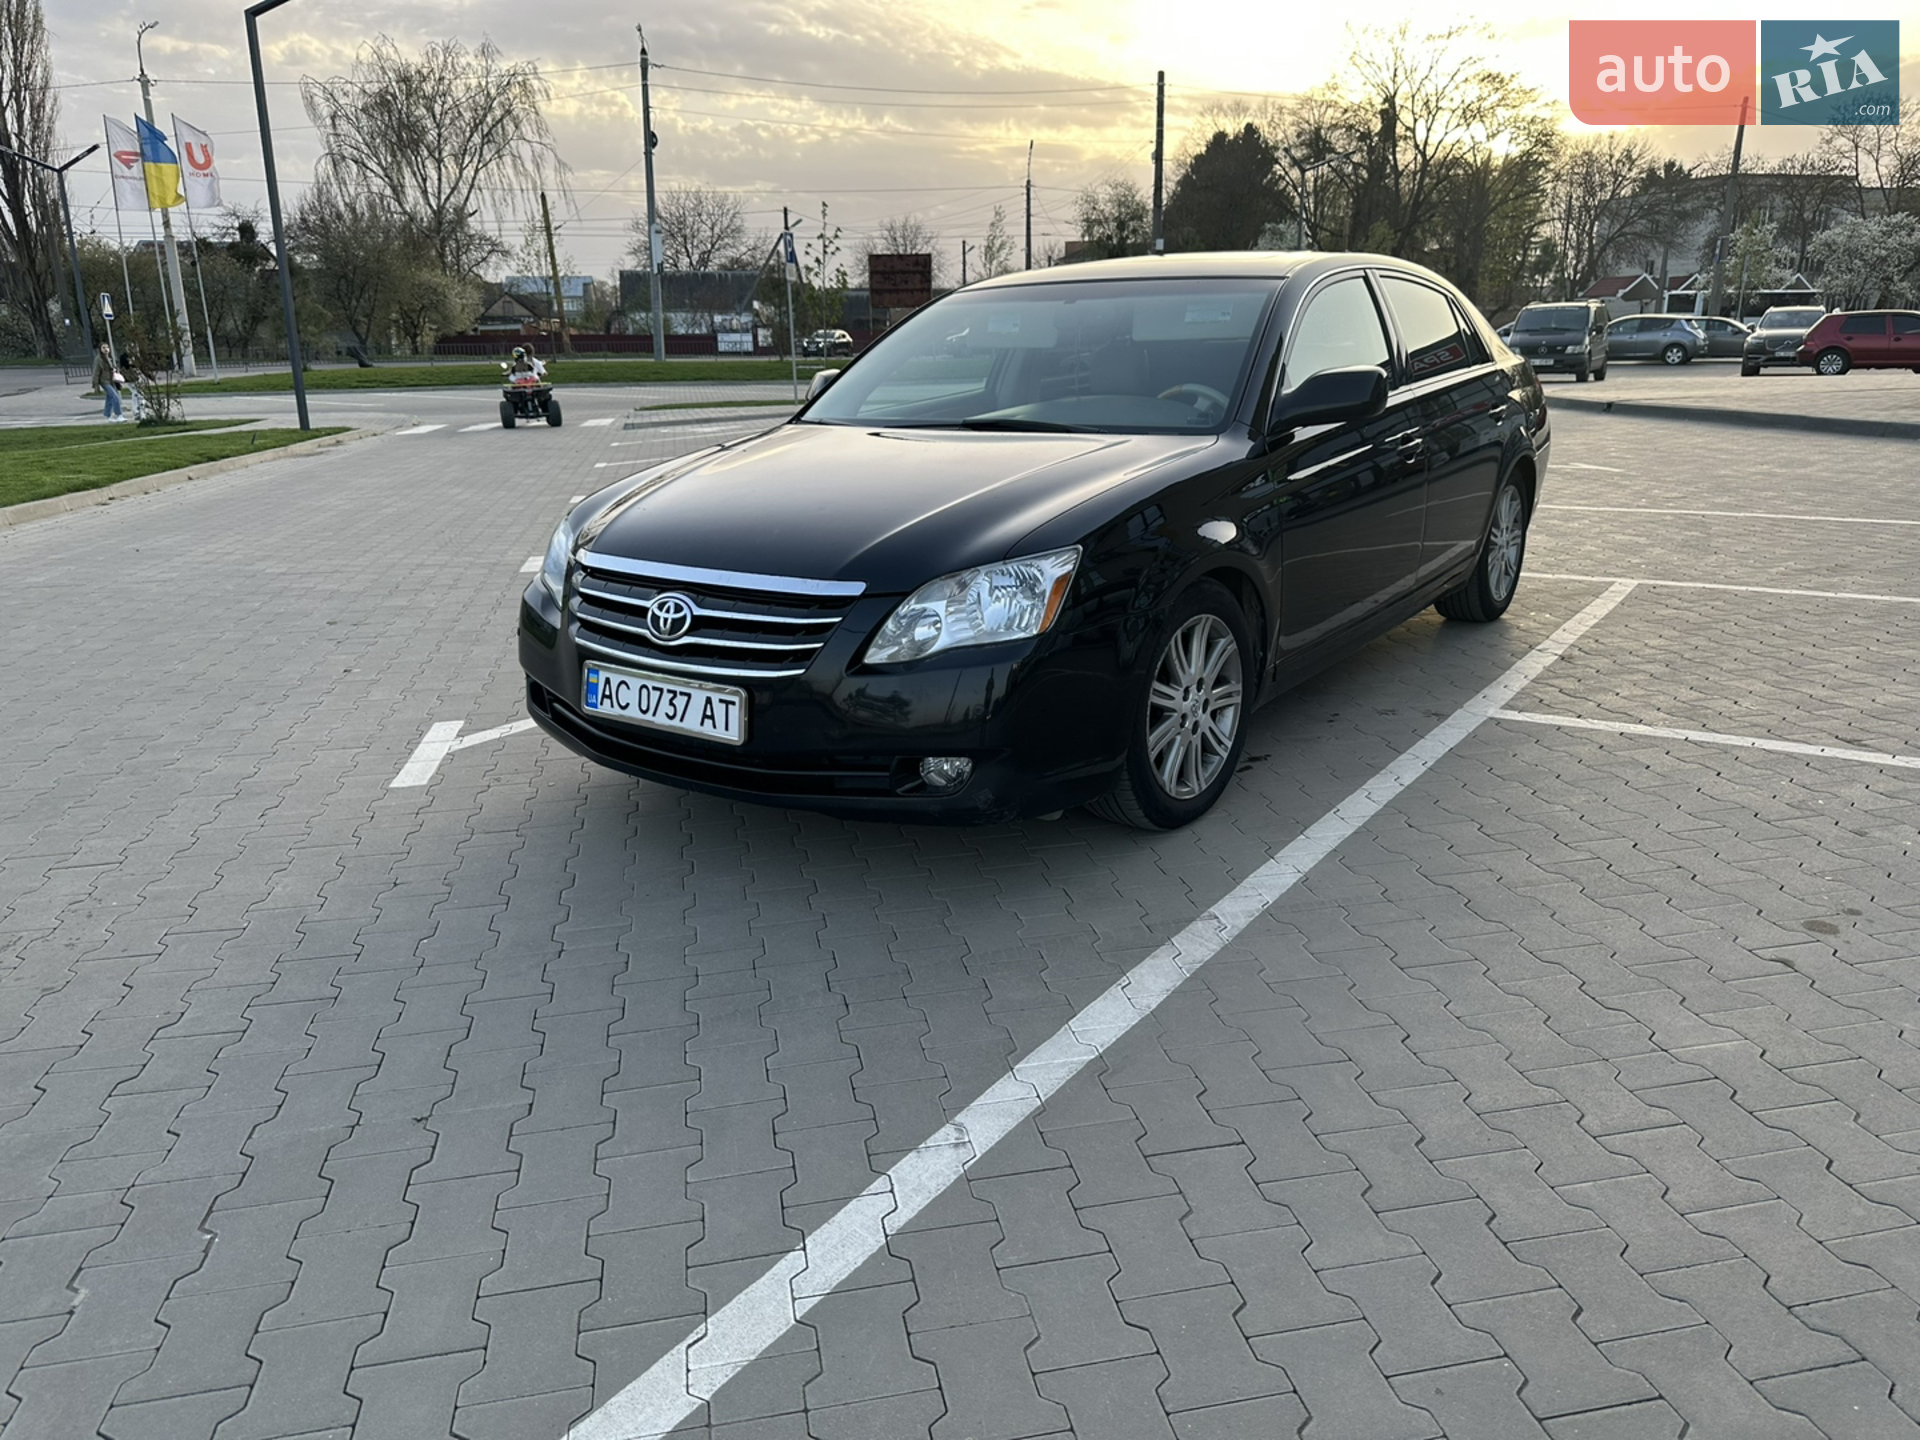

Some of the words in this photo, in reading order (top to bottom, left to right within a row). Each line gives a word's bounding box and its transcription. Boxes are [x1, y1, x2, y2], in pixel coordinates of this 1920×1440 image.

[587, 693, 597, 704] UA
[600, 676, 631, 711] AC
[638, 684, 692, 723] 0737
[700, 695, 736, 732] AT
